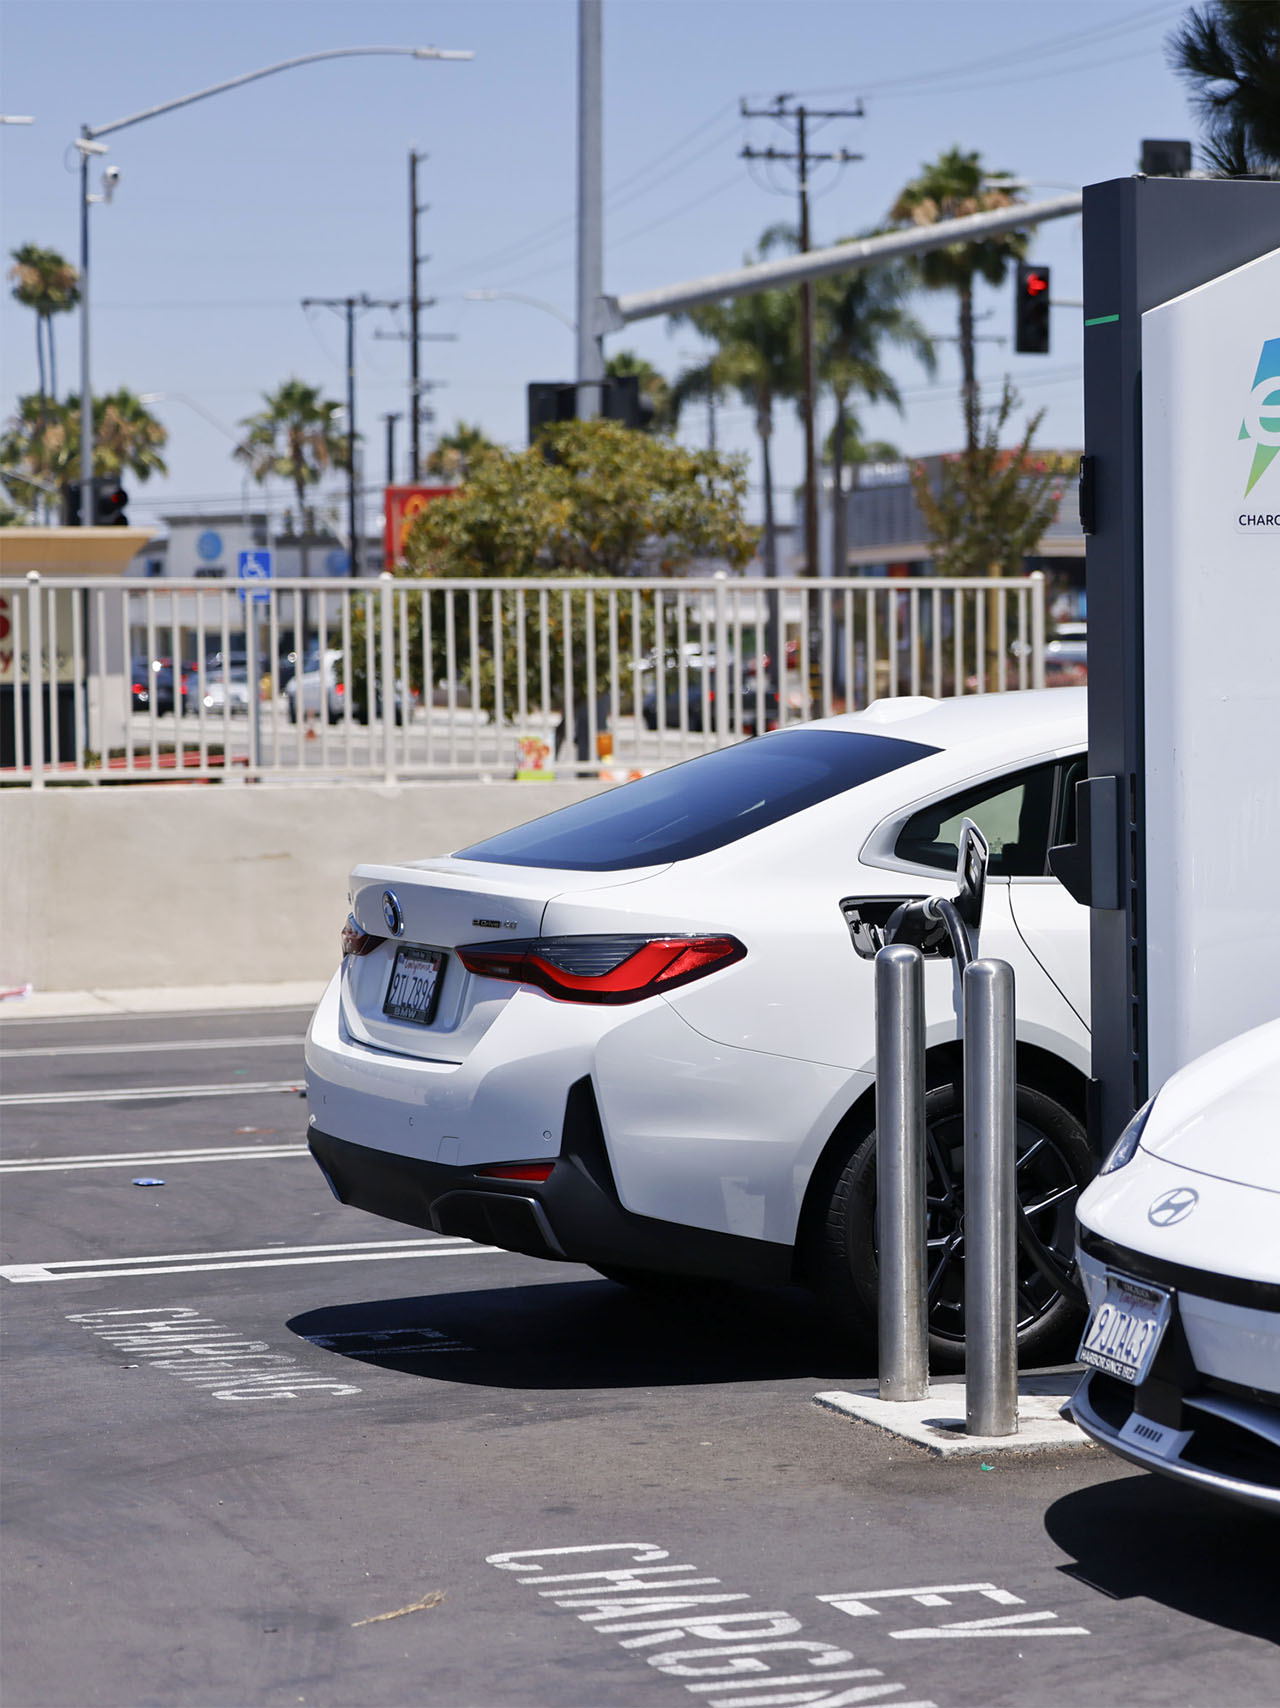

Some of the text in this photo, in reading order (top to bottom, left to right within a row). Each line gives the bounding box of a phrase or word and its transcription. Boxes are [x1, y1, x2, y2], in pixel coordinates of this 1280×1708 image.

[390, 973, 436, 1010] 9TLZ896
[394, 1006, 417, 1019] BMW
[65, 1307, 363, 1400] CHARGING
[298, 1327, 480, 1356] EV
[1104, 1358, 1123, 1376] SINCE
[817, 1582, 1092, 1640] EV
